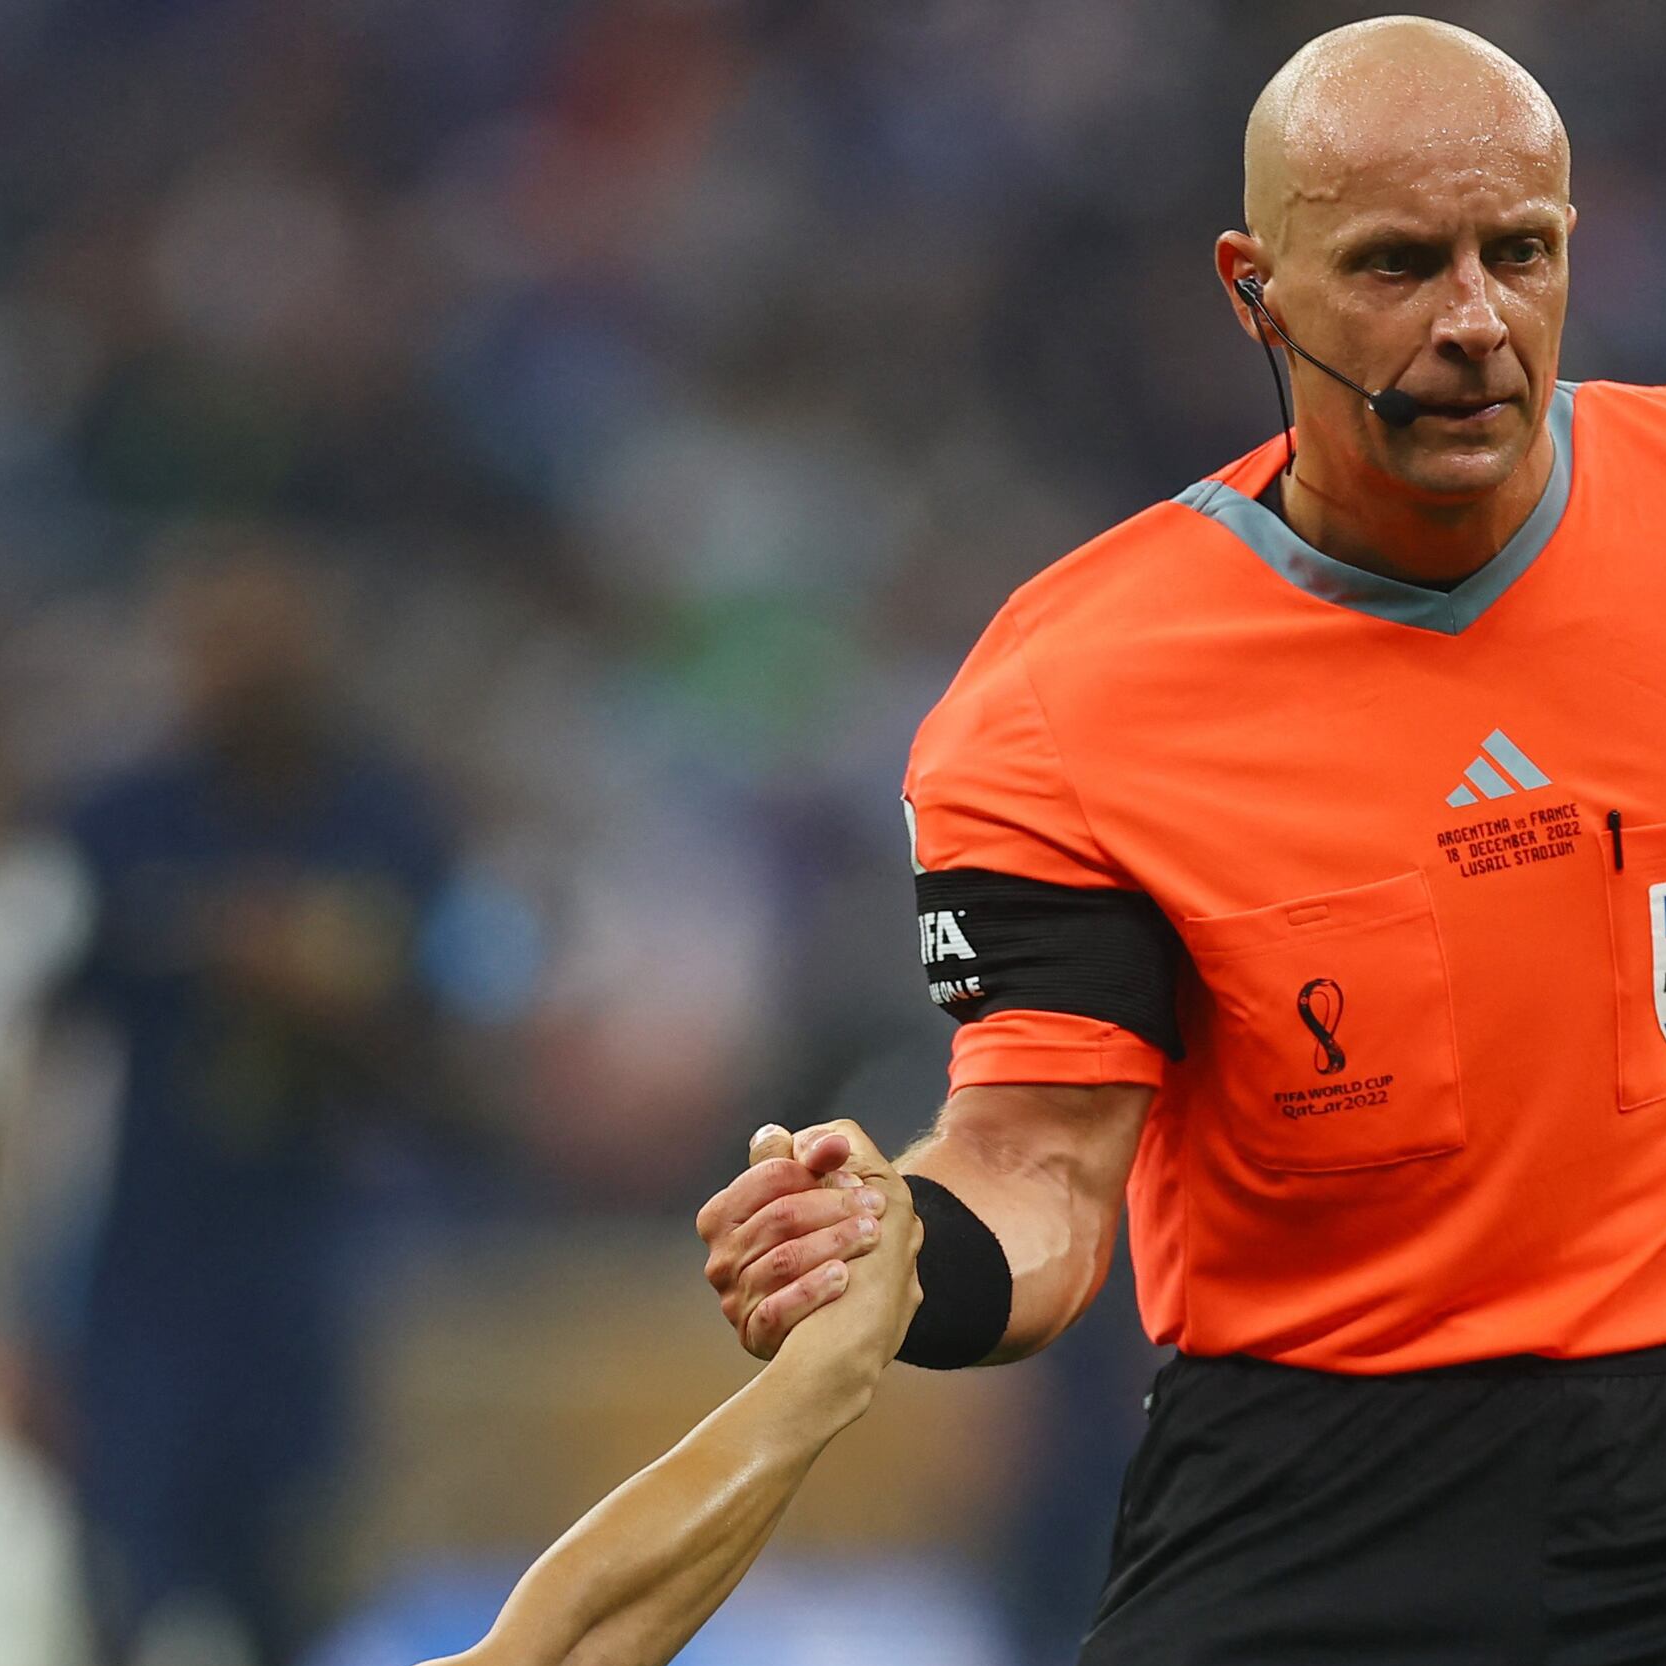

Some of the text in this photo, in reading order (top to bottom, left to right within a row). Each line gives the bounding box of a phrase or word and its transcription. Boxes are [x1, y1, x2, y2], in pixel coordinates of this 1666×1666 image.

[1437, 818, 1511, 848] ARGENTINA
[1529, 803, 1580, 827] FRANCE
[1445, 820, 1582, 864] 18 DECEMBER 2022
[1460, 840, 1576, 878] LUSAIL STADIUM
[918, 910, 978, 965] IFA
[1274, 1074, 1394, 1104] FIFA WORLD CUP
